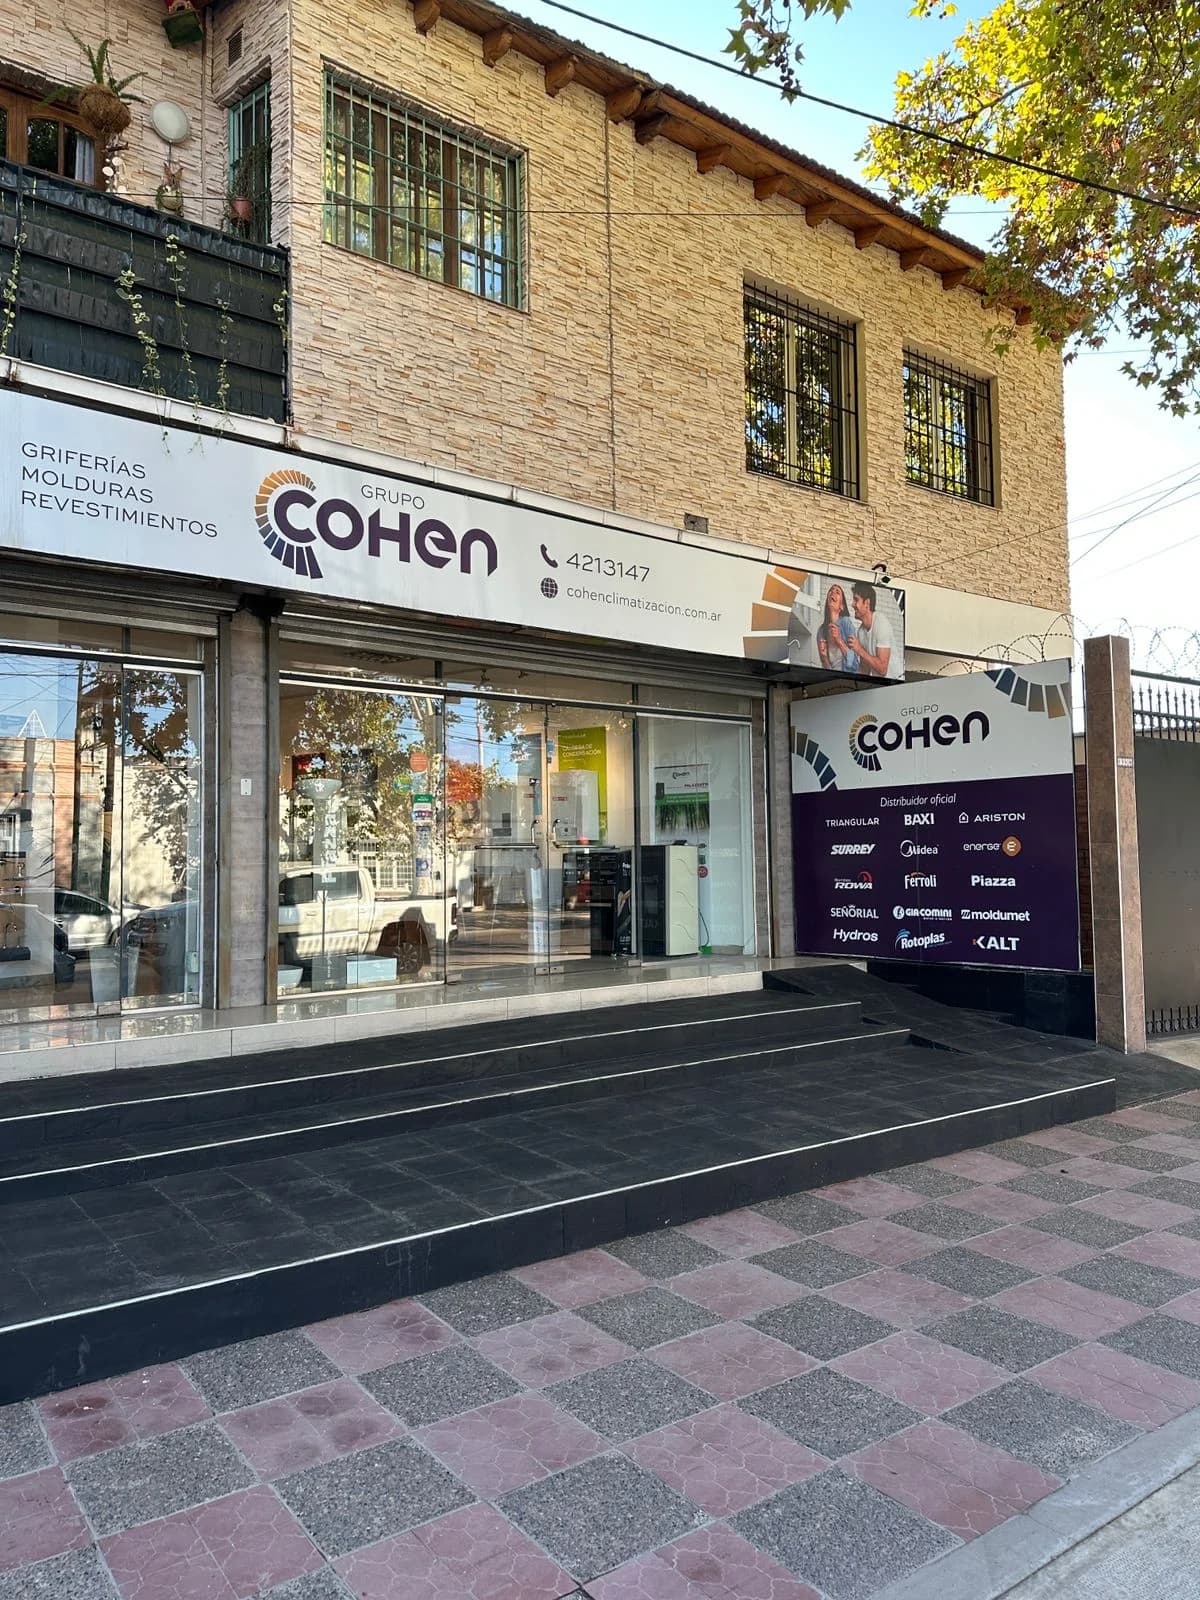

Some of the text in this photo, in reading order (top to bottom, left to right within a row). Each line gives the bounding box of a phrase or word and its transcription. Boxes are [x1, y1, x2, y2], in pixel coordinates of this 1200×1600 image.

[21, 442, 146, 479] GRIFERÍAS
[22, 466, 153, 503] MOLDURAS
[360, 484, 425, 510] GRUPO
[21, 490, 218, 538] REVESTIMIENTOS
[566, 552, 650, 582] 4213147
[566, 586, 721, 622] cohenclimatizacion.com.ar
[900, 704, 939, 717] GRUPO
[880, 793, 957, 807] Distribuidor oficial
[825, 817, 880, 827] TRIANGULAR
[904, 812, 935, 826] BAXI
[974, 812, 1026, 822] ARISTON
[830, 843, 876, 855] SURREY
[901, 840, 939, 857] Midea
[834, 882, 873, 890] ROWA
[904, 874, 937, 889] Ferroli
[971, 875, 1016, 887] Piazza
[830, 904, 879, 919] SEÑORIAL
[905, 907, 952, 918] GIACOMINI
[971, 909, 1031, 922] moldumet
[832, 928, 879, 942] Hydros
[900, 932, 945, 950] Rotoplas
[973, 935, 1020, 951] KALT
